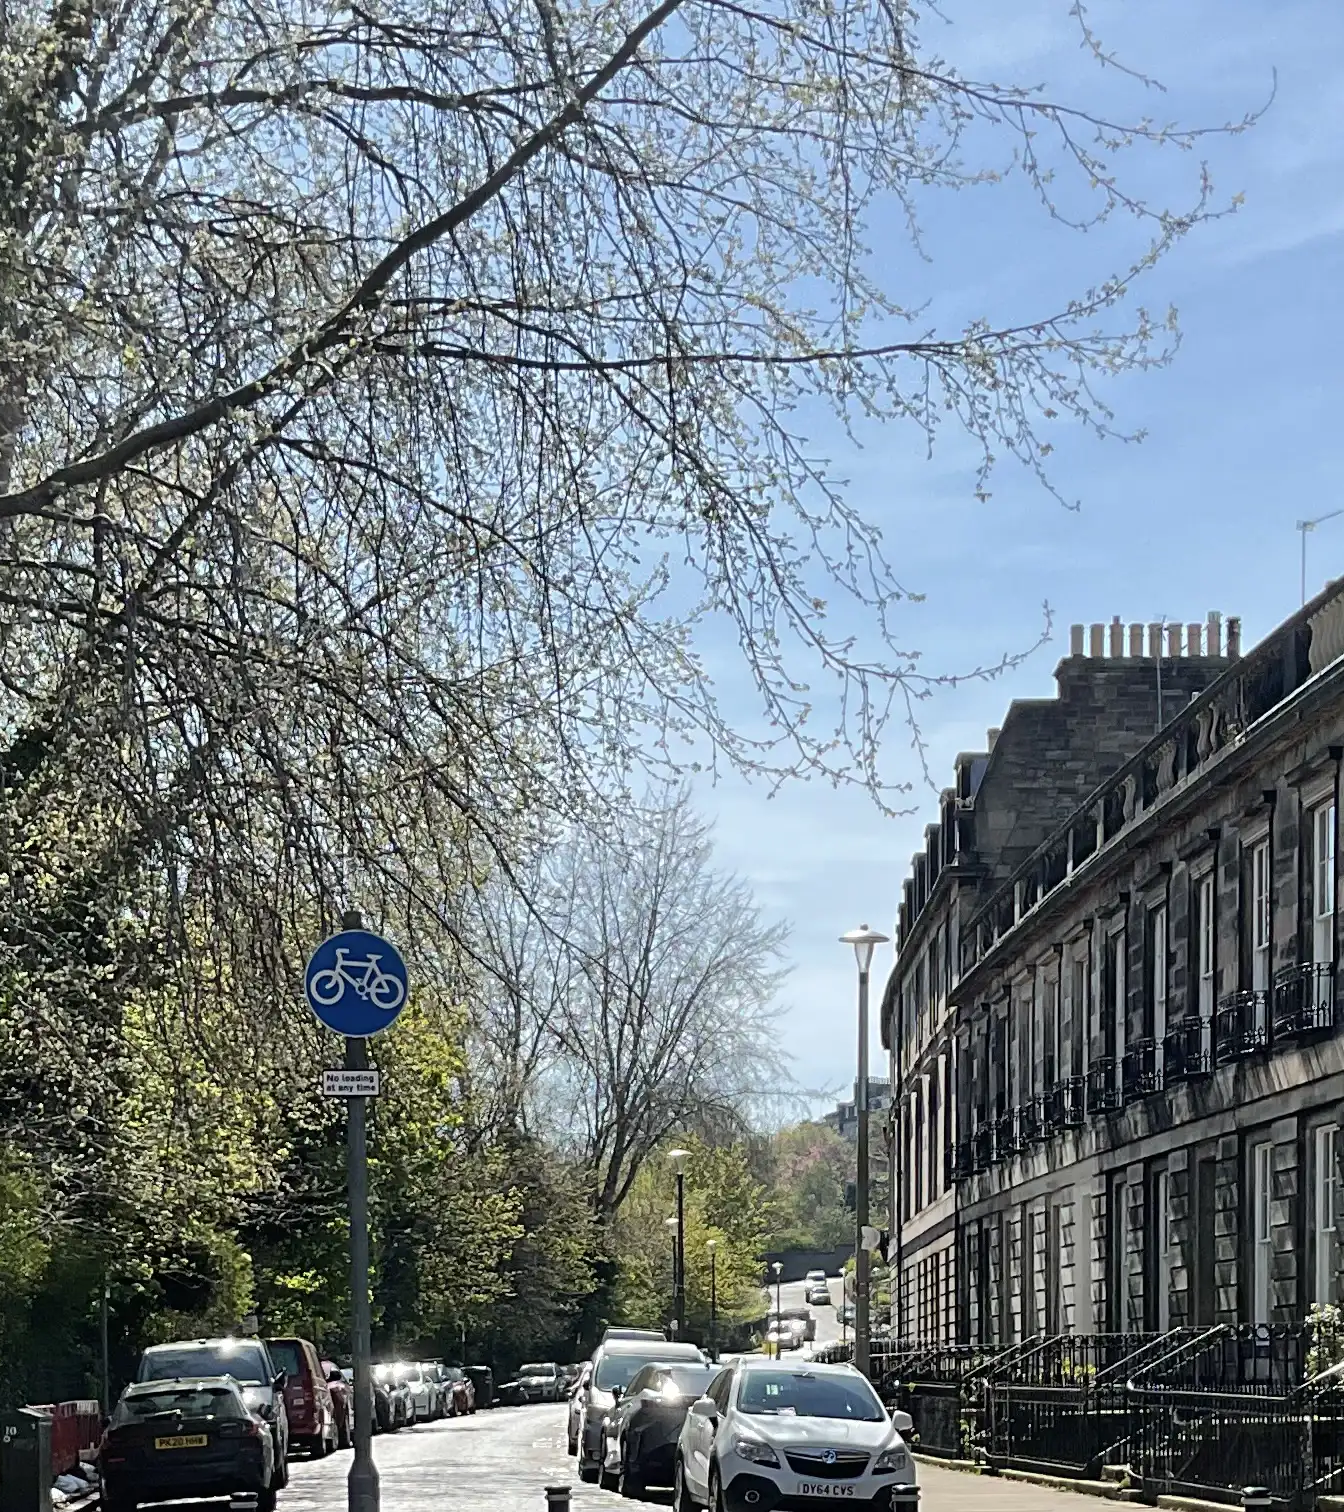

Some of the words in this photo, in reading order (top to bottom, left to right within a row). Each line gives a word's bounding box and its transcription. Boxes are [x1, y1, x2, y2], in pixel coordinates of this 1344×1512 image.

[327, 1074, 339, 1082] No
[342, 1074, 374, 1083] loading
[803, 1484, 829, 1494] DY64
[833, 1485, 853, 1496] CVS
